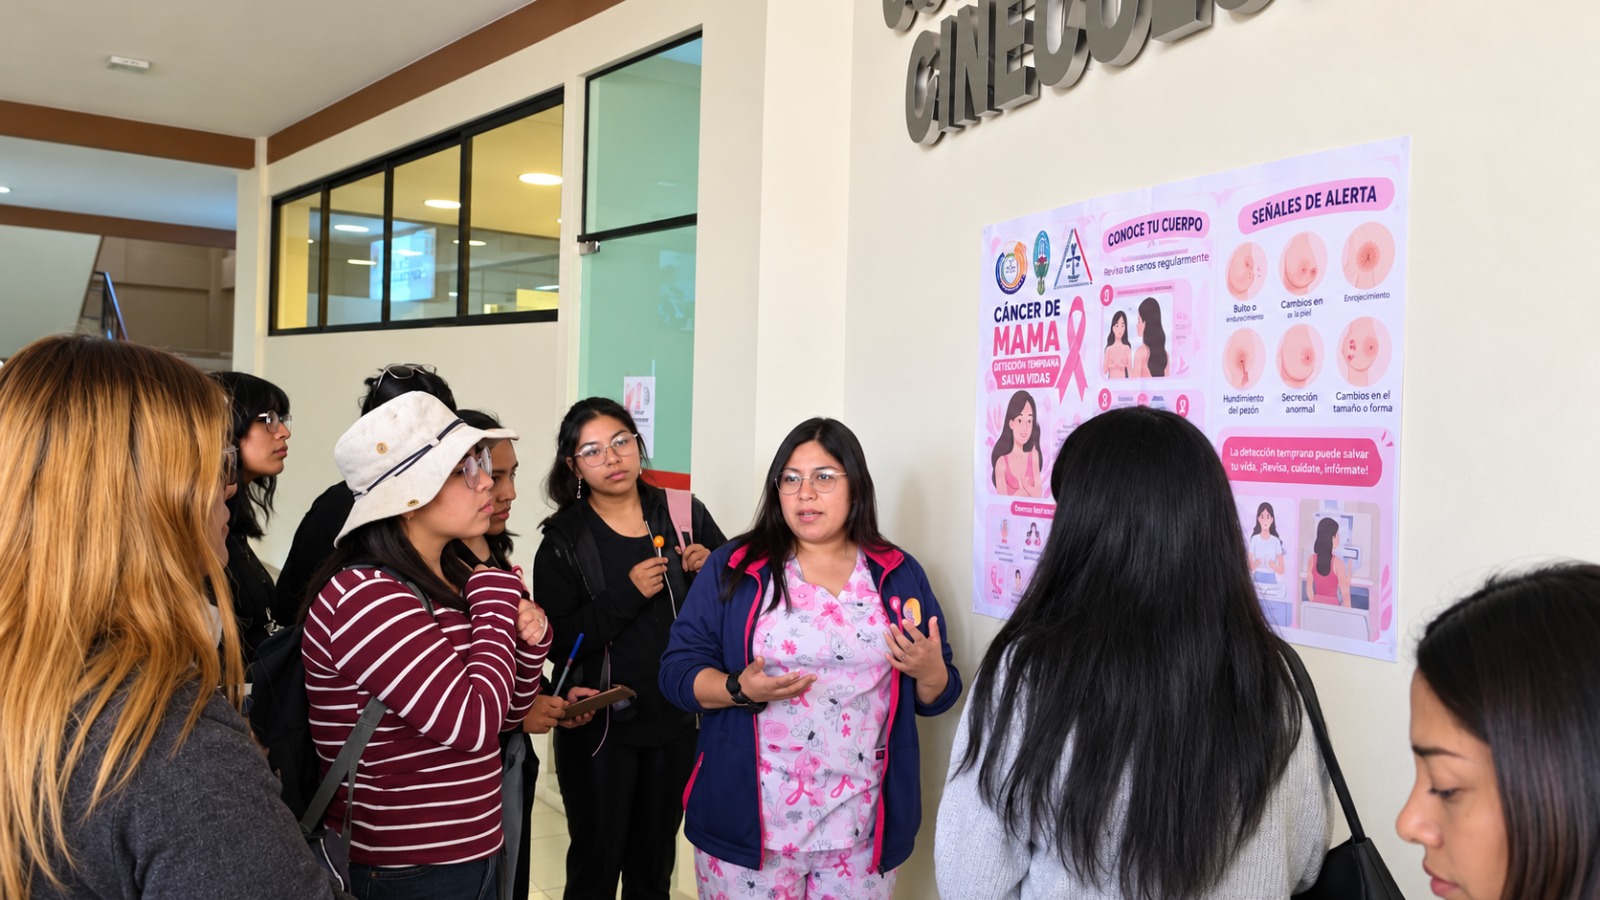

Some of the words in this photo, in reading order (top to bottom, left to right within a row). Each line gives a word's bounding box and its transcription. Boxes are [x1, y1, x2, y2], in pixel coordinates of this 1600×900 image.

[1252, 196, 1302, 226] SEÑALES
[1305, 192, 1322, 210] DE
[1325, 185, 1377, 208] ALERTA
[1108, 222, 1145, 247] CONOCE
[1147, 219, 1159, 235] TU
[1162, 216, 1203, 232] CUERPO
[1124, 265, 1135, 273] tus
[1136, 261, 1157, 271] senos
[1158, 253, 1210, 270] regularmente
[1280, 298, 1313, 309] Cambios
[1313, 297, 1324, 306] en
[1343, 292, 1391, 303] Enrojecimiento
[994, 301, 1041, 323] CÁNCER
[1045, 299, 1060, 317] DE
[993, 320, 1060, 356] MAMA
[1001, 373, 1025, 386] SALVA
[1026, 372, 1051, 385] VIDAS
[1223, 393, 1264, 403] Hundimiento
[1281, 392, 1318, 402] Secreción
[1335, 391, 1370, 401] Cambios
[1371, 392, 1381, 400] en
[1383, 390, 1391, 399] el
[1228, 406, 1239, 414] del
[1285, 404, 1316, 413] anormal
[1333, 403, 1361, 413] tamaño
[1369, 403, 1393, 413] forma
[1230, 447, 1239, 457] La
[1315, 448, 1342, 461] puede
[1343, 448, 1370, 459] salvar
[1231, 462, 1239, 471] tu
